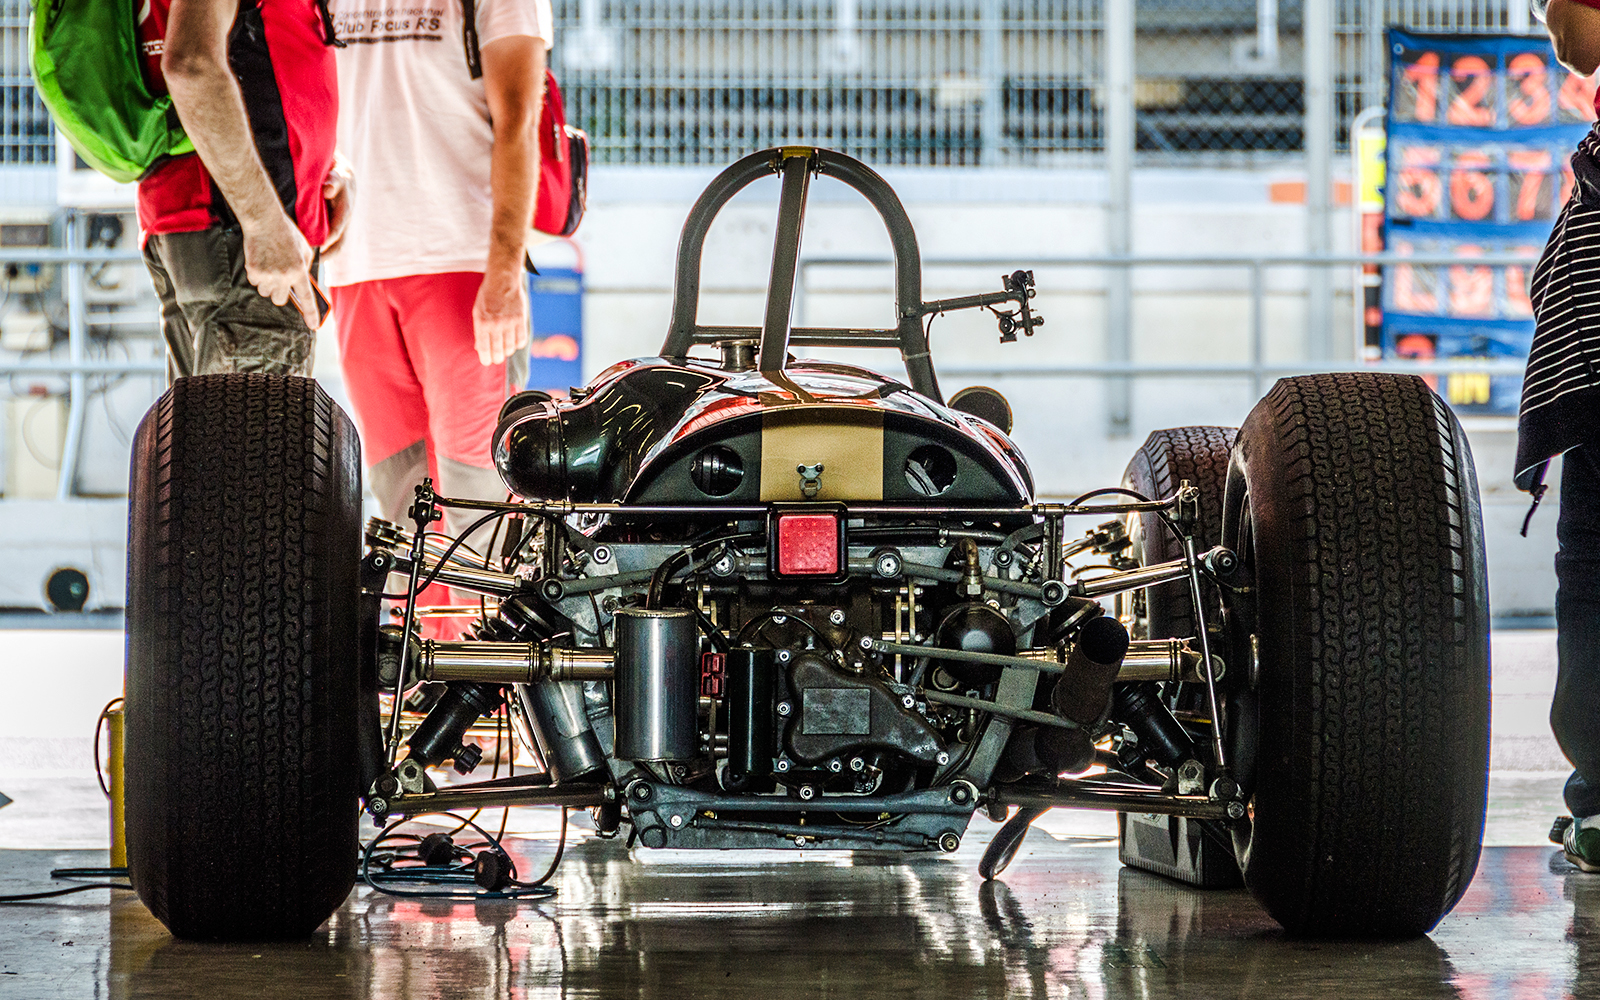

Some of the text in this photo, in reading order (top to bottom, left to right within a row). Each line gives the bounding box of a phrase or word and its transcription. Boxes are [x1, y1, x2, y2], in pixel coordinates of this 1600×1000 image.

[334, 17, 441, 34] Club Focus RS
[337, 7, 399, 20] Concentraón
[1404, 52, 1440, 122] 1
[1447, 55, 1497, 126] 2
[1508, 53, 1551, 125] 3
[1451, 151, 1495, 220] 6
[1508, 151, 1552, 220] 7
